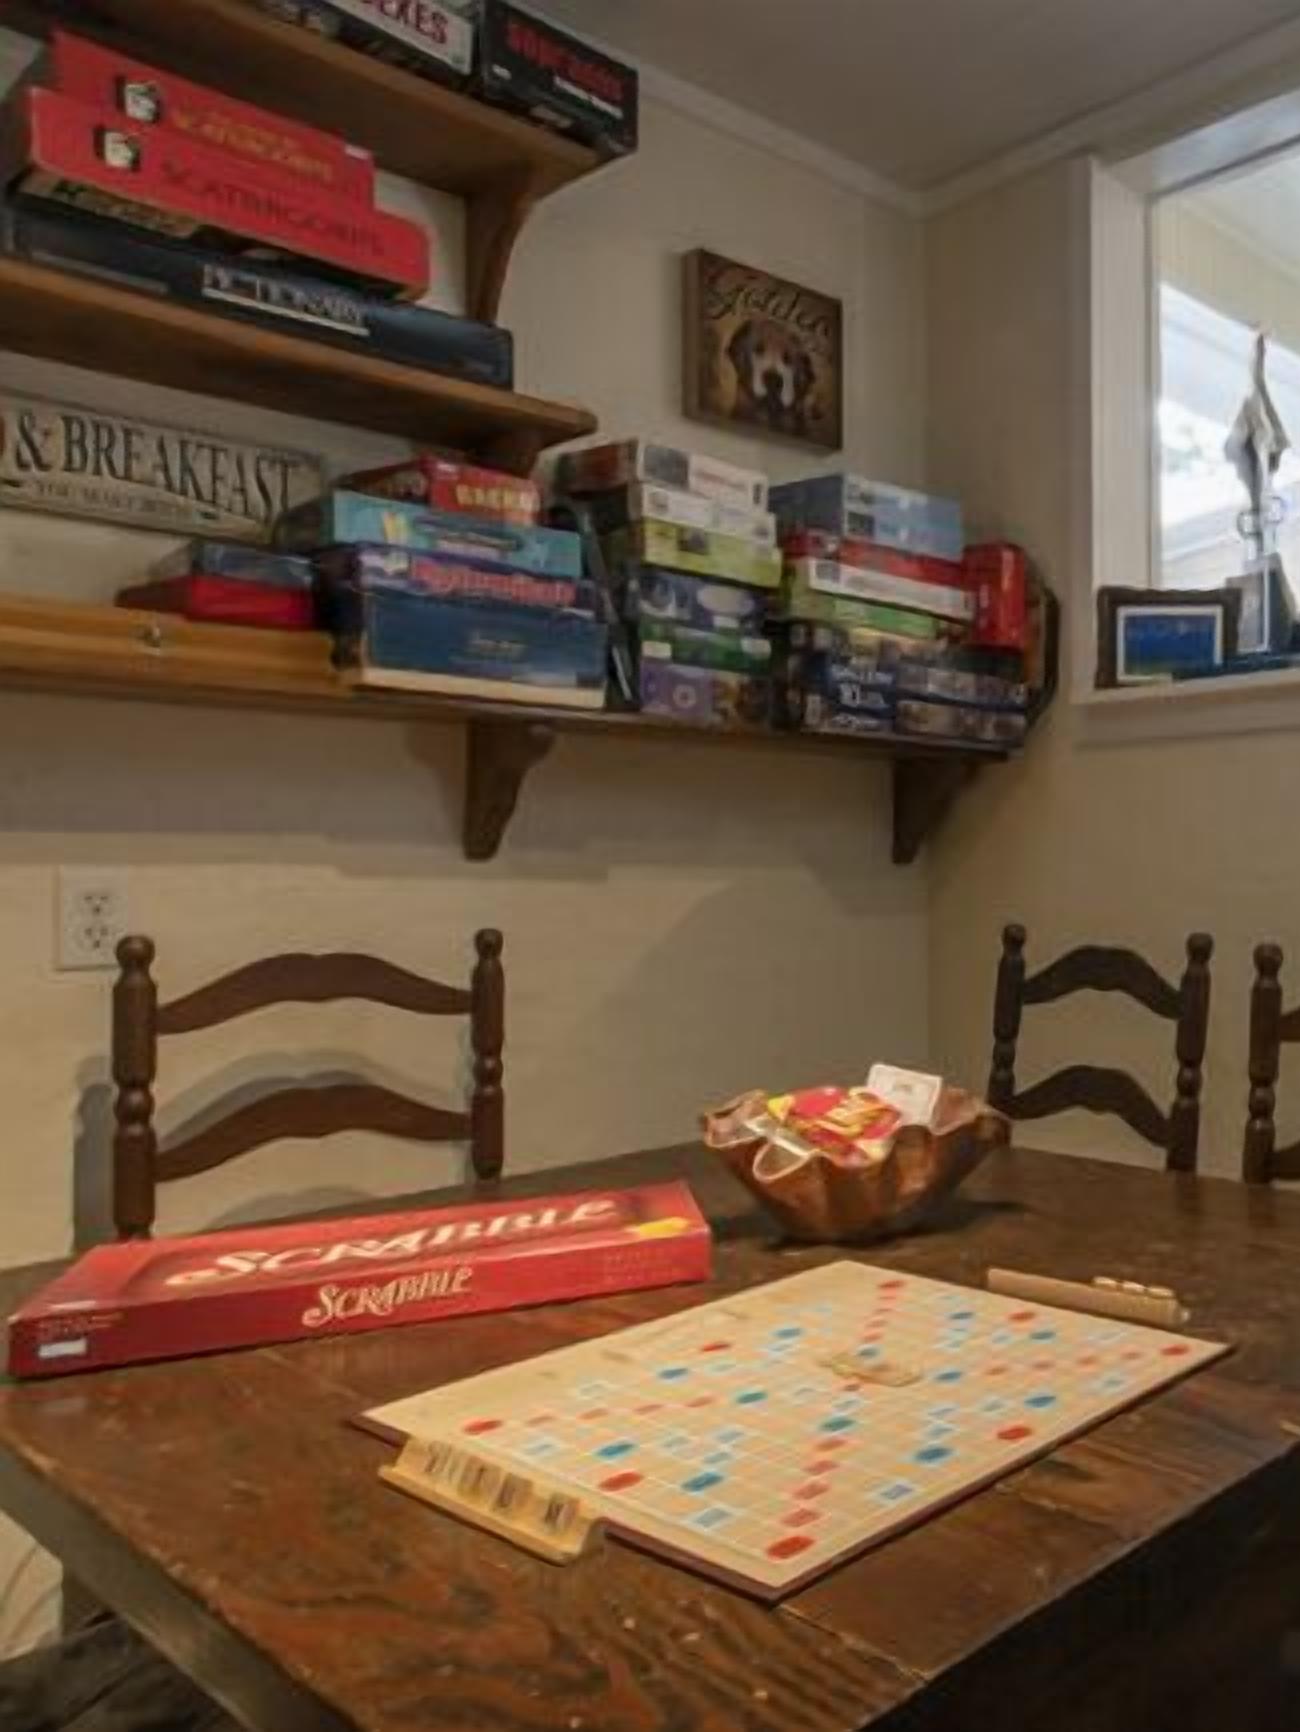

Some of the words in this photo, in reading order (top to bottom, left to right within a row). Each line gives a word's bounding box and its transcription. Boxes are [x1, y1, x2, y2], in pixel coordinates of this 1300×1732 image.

[15, 410, 53, 472] &
[60, 415, 298, 525] BREAKFAST
[302, 1265, 474, 1328] SCRABBLE
